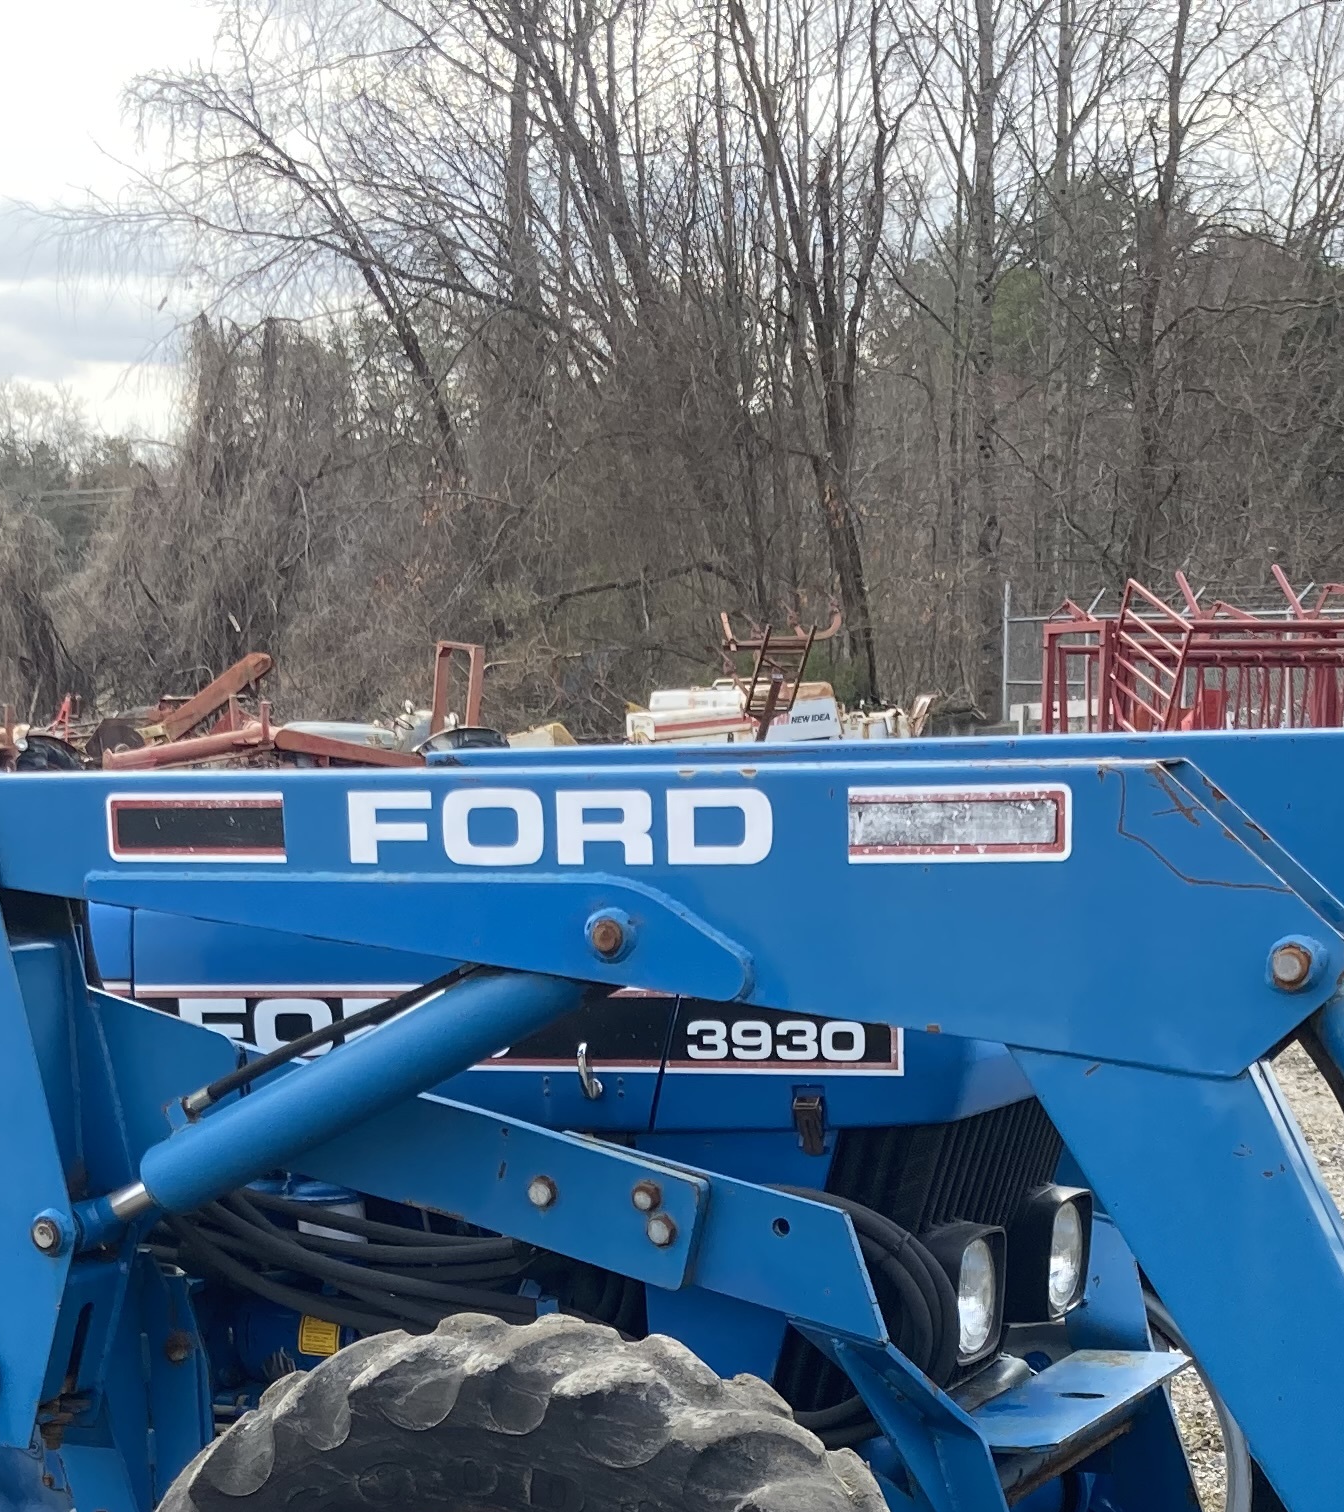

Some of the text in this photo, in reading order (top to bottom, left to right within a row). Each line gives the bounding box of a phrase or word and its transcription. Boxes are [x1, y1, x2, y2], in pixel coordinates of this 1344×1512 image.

[791, 715, 810, 724] NEW
[811, 713, 830, 722] IDEA
[347, 787, 773, 866] FORD
[686, 1019, 866, 1062] 3930
